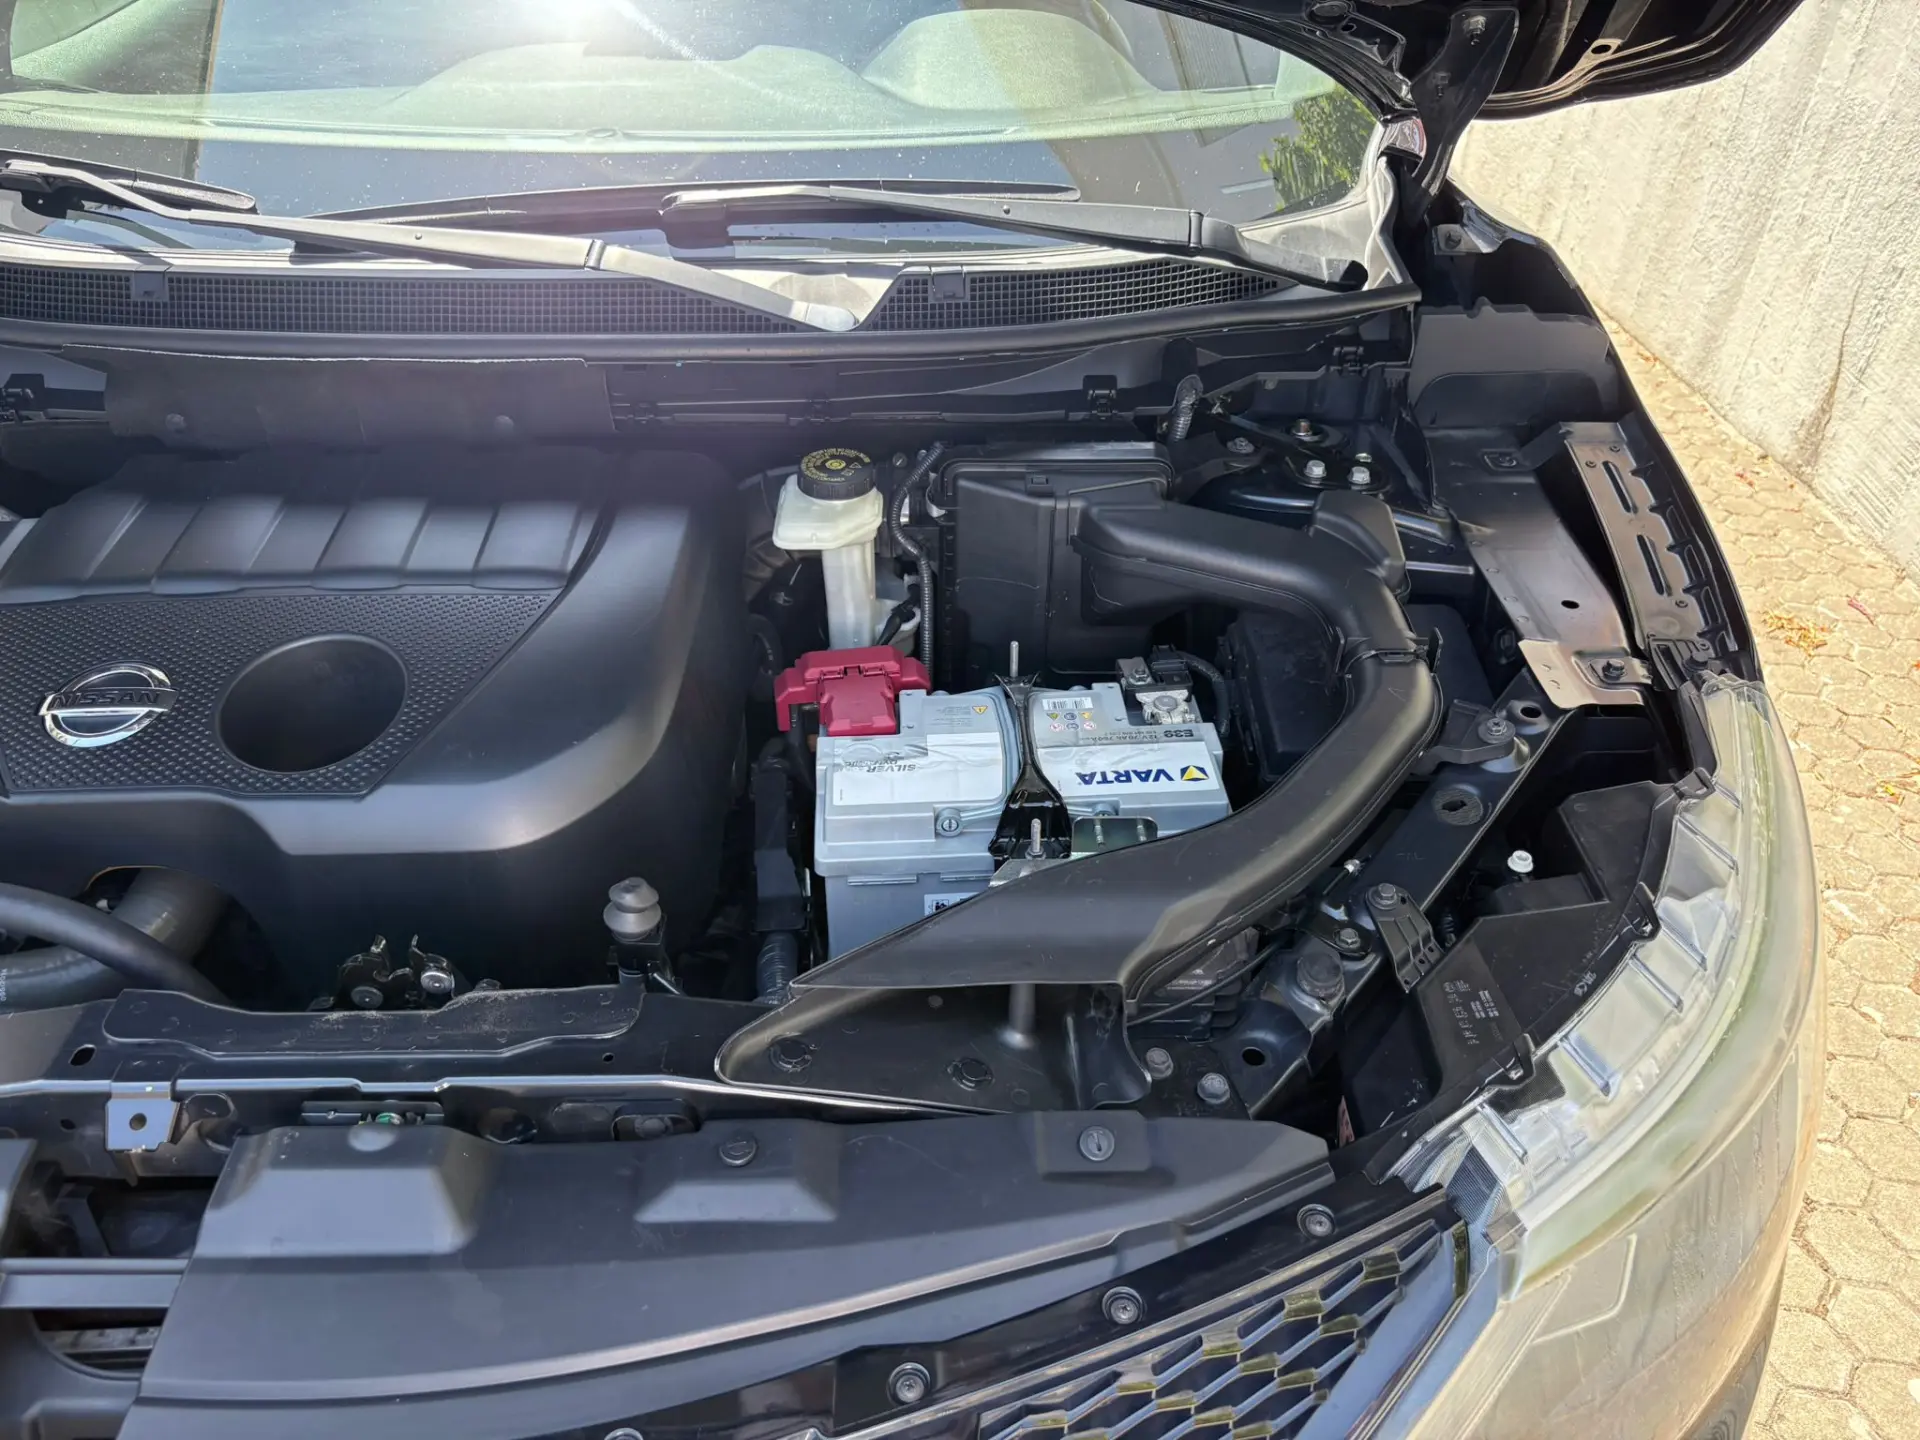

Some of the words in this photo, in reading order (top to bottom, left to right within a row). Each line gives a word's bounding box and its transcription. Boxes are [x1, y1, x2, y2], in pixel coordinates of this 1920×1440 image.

[51, 690, 160, 707] NISSAN
[1163, 729, 1194, 738] E39
[866, 764, 916, 773] SILVER
[1075, 769, 1175, 785] VARTA
